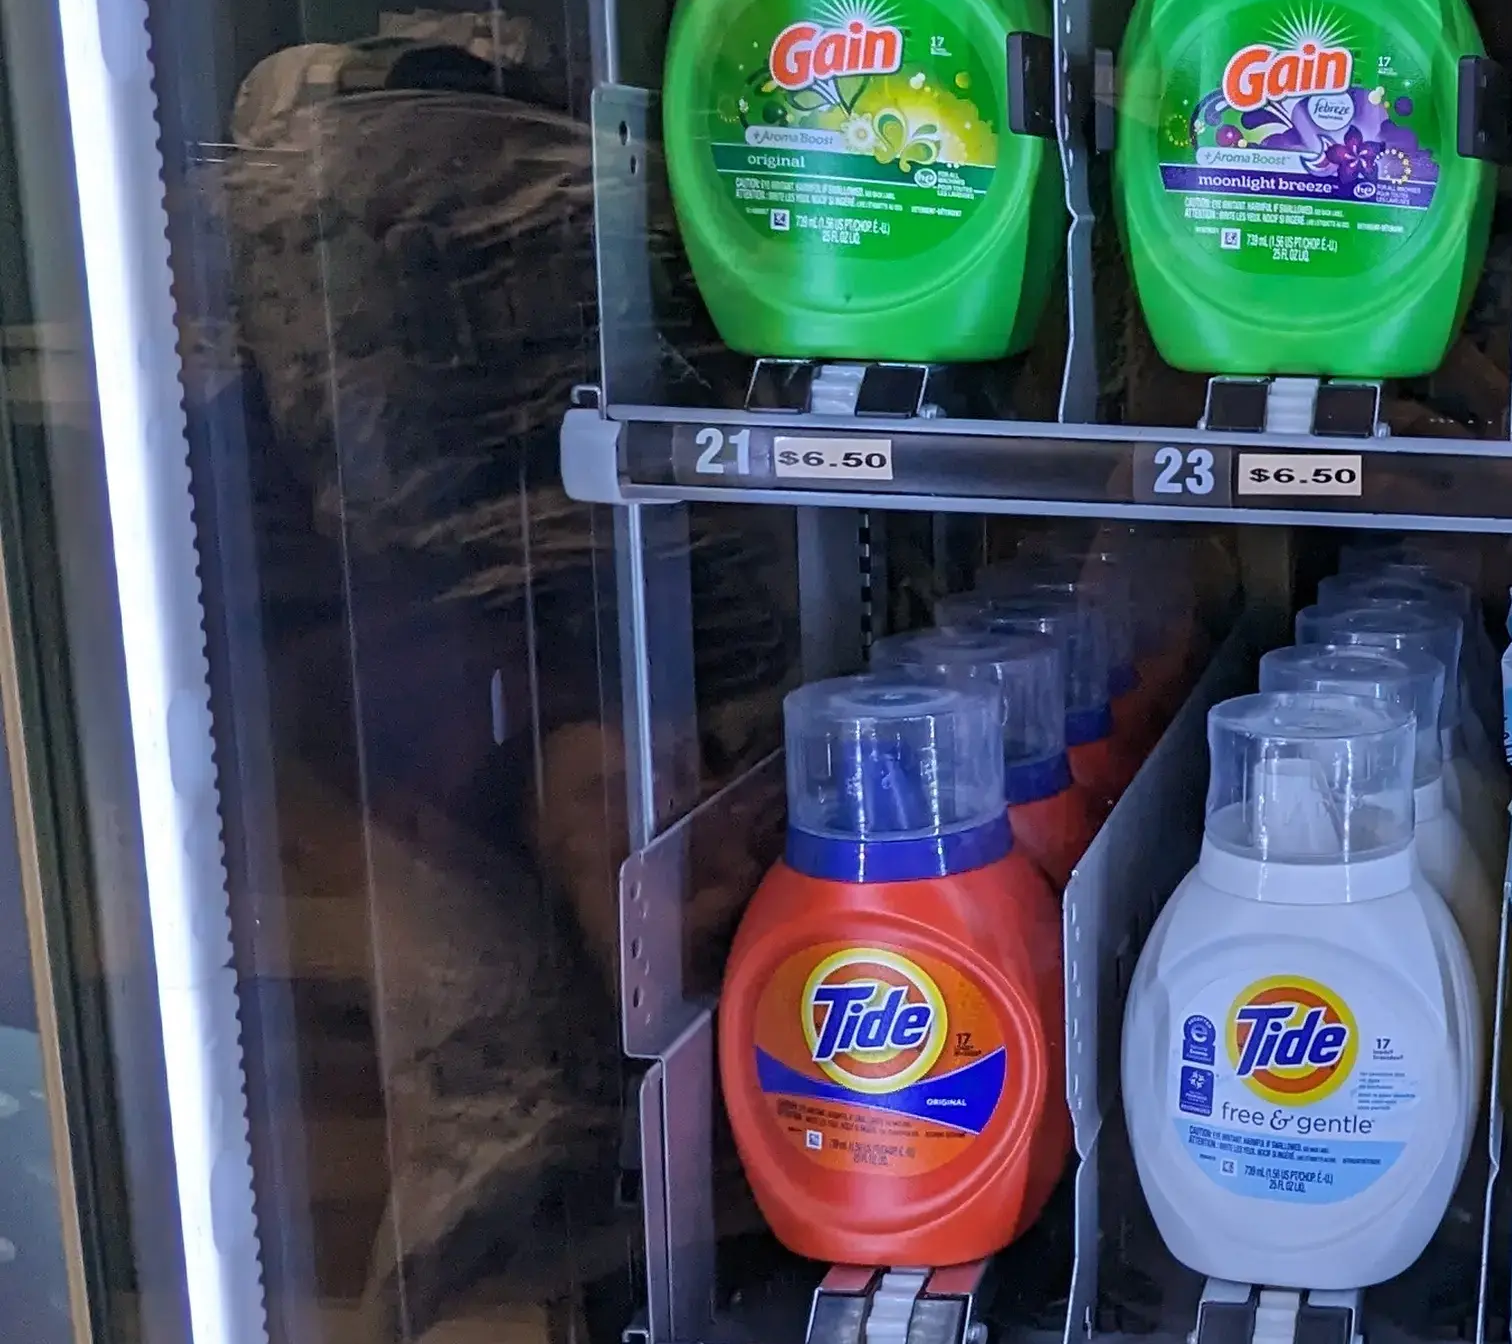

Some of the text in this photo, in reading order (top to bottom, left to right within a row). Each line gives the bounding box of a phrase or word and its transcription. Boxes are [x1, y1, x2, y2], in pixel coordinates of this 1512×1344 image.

[930, 36, 944, 47] 17
[771, 21, 901, 90] Gain
[1378, 56, 1390, 67] 17
[1224, 44, 1352, 109] Gain
[1312, 98, 1350, 116] febreze
[800, 133, 834, 145] Boost
[747, 155, 805, 169] original
[1214, 150, 1286, 166] Aroma Boost
[1199, 174, 1332, 194] moonlight breeze
[695, 427, 750, 474] 21
[777, 450, 887, 469] $6.50
[1154, 447, 1215, 494] 23
[1250, 468, 1356, 484] $6.50
[813, 983, 932, 1061] Tide
[956, 1032, 972, 1046] 17
[1236, 1006, 1348, 1078] Tide
[1375, 1038, 1391, 1049] 17
[926, 1098, 967, 1106] ORIGINAL
[1222, 1101, 1265, 1127] free
[1270, 1109, 1295, 1130] &
[1297, 1115, 1373, 1135] gentle
